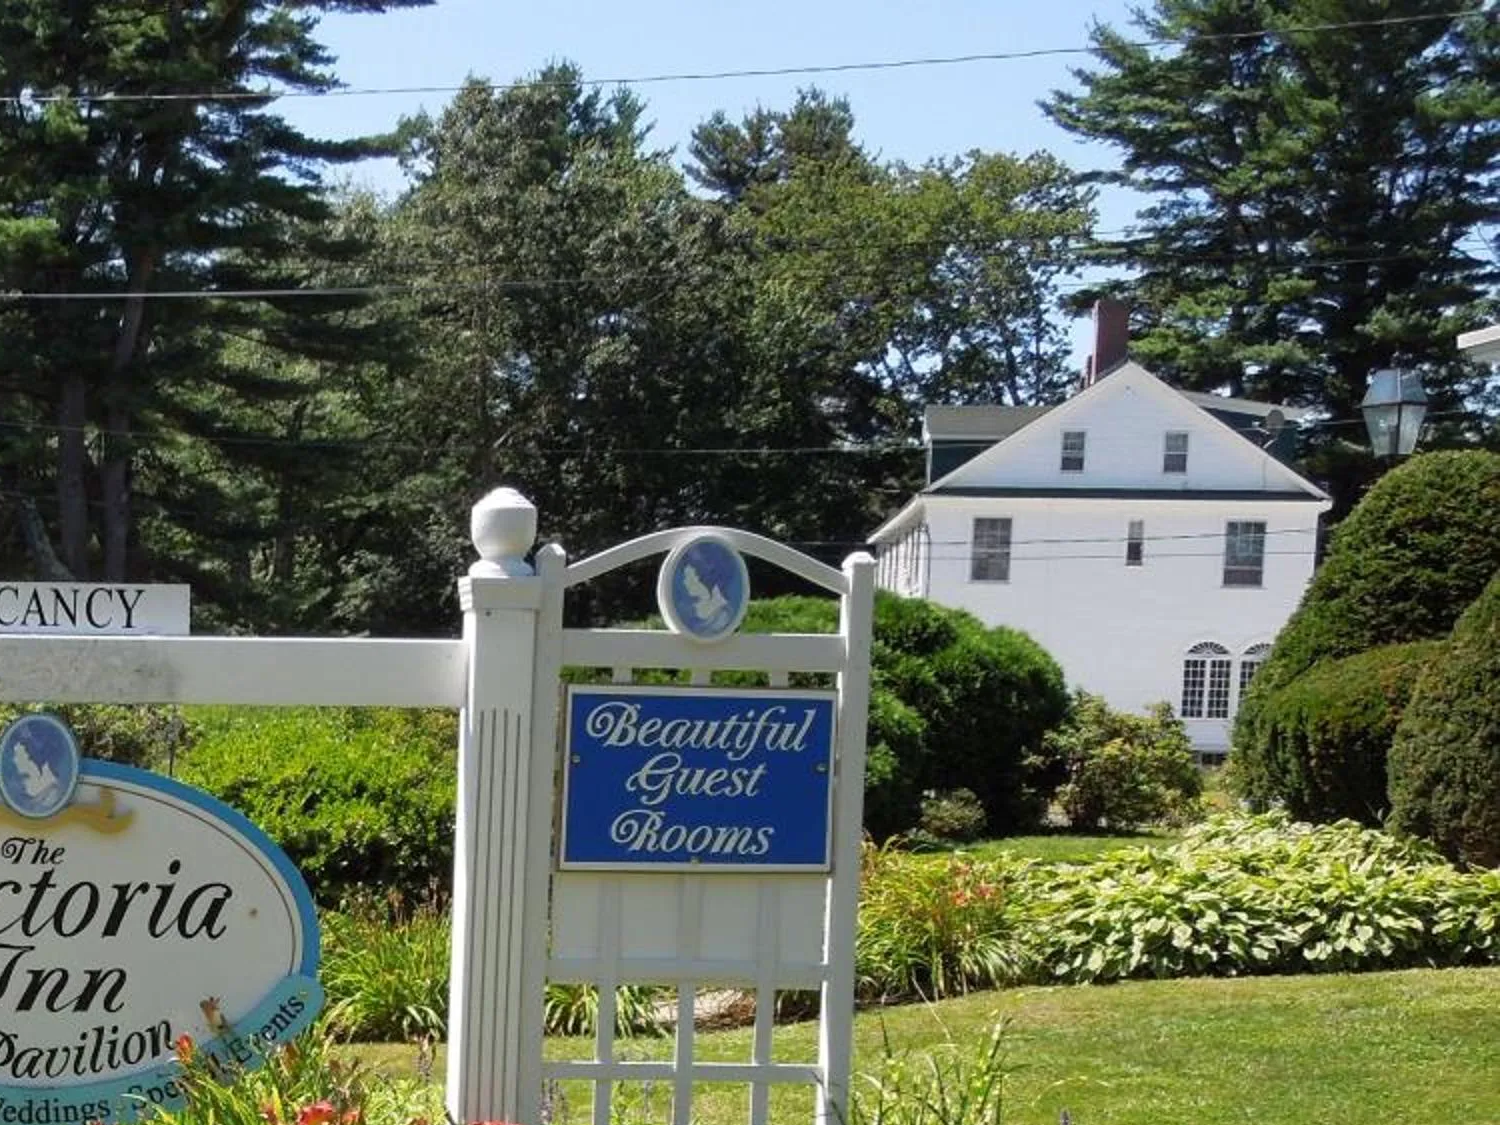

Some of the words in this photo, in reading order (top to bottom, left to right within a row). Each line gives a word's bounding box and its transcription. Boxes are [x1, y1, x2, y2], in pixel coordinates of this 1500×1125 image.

[585, 701, 817, 761] Beautiful
[626, 751, 767, 805] Guest
[1, 836, 66, 866] The
[610, 809, 775, 855] Rooms
